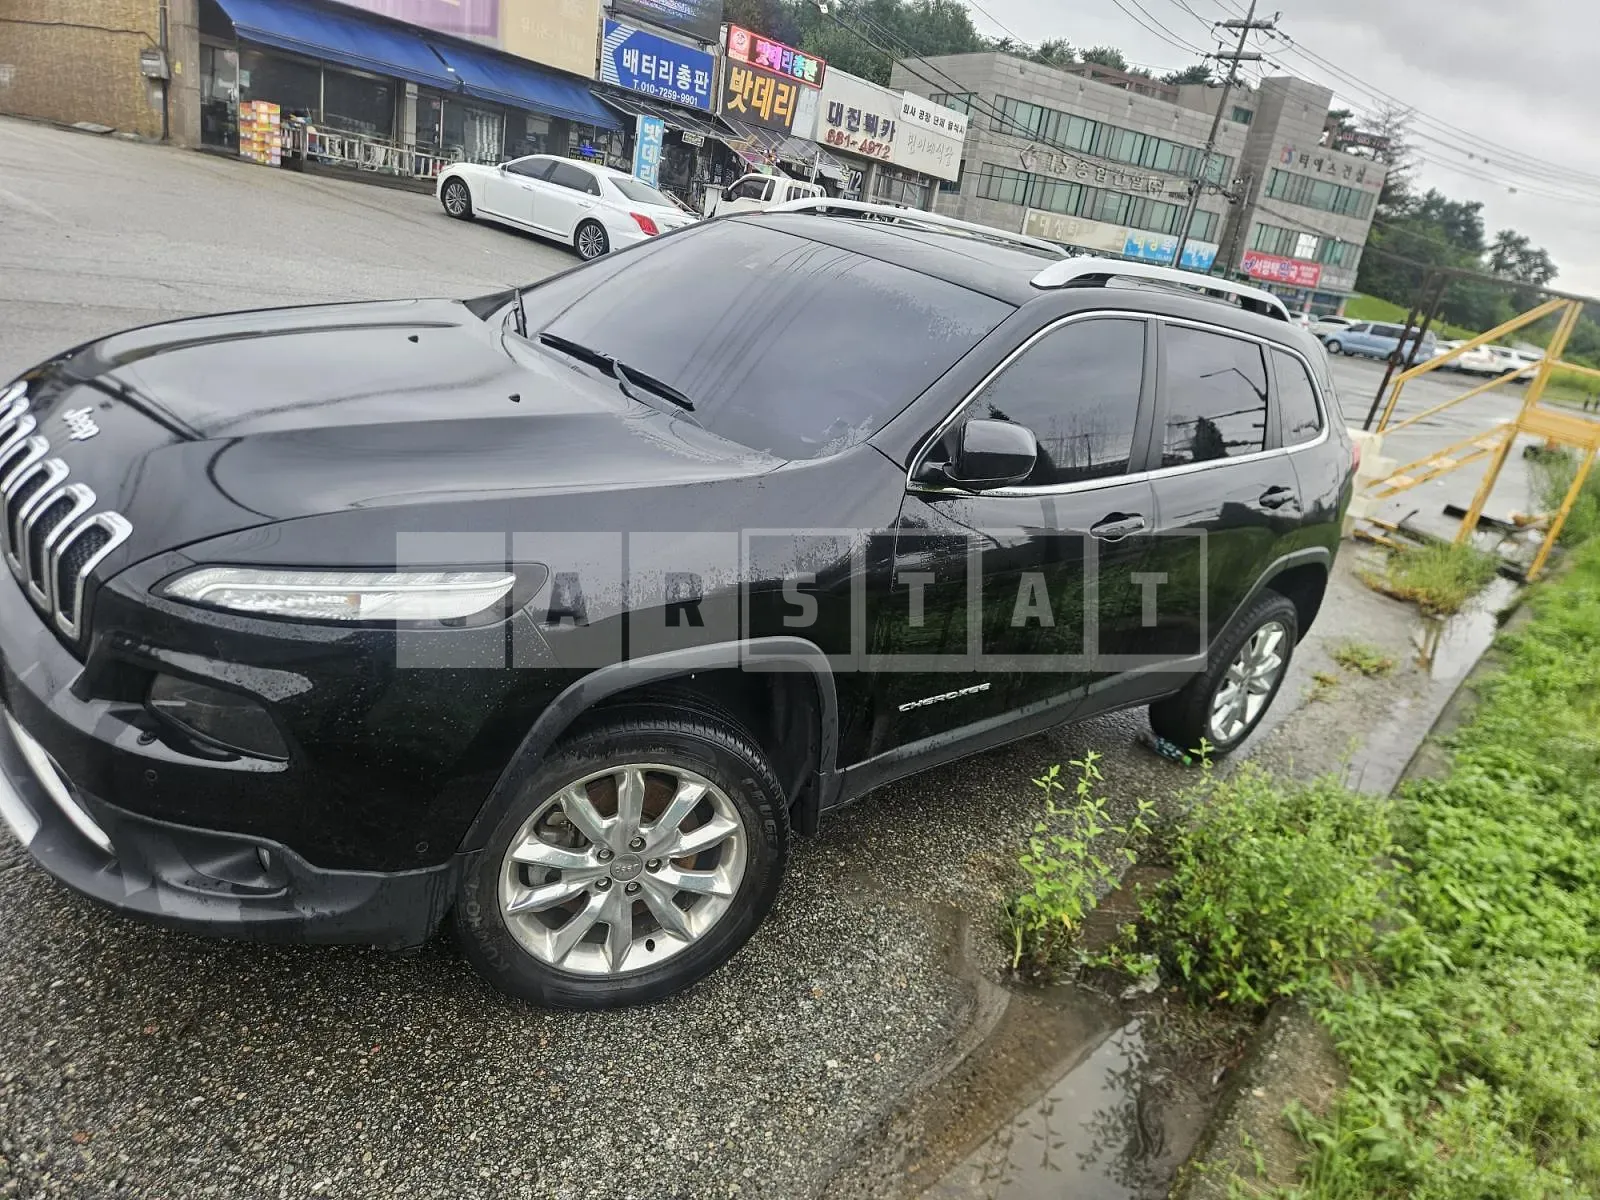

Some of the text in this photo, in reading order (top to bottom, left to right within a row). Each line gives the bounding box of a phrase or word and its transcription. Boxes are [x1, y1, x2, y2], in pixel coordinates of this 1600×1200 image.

[622, 48, 709, 95] 배터리총판
[728, 66, 797, 127] 밧데리
[903, 103, 916, 117] 회사
[918, 109, 931, 123] 공장
[898, 682, 992, 713] CHEROKEE
